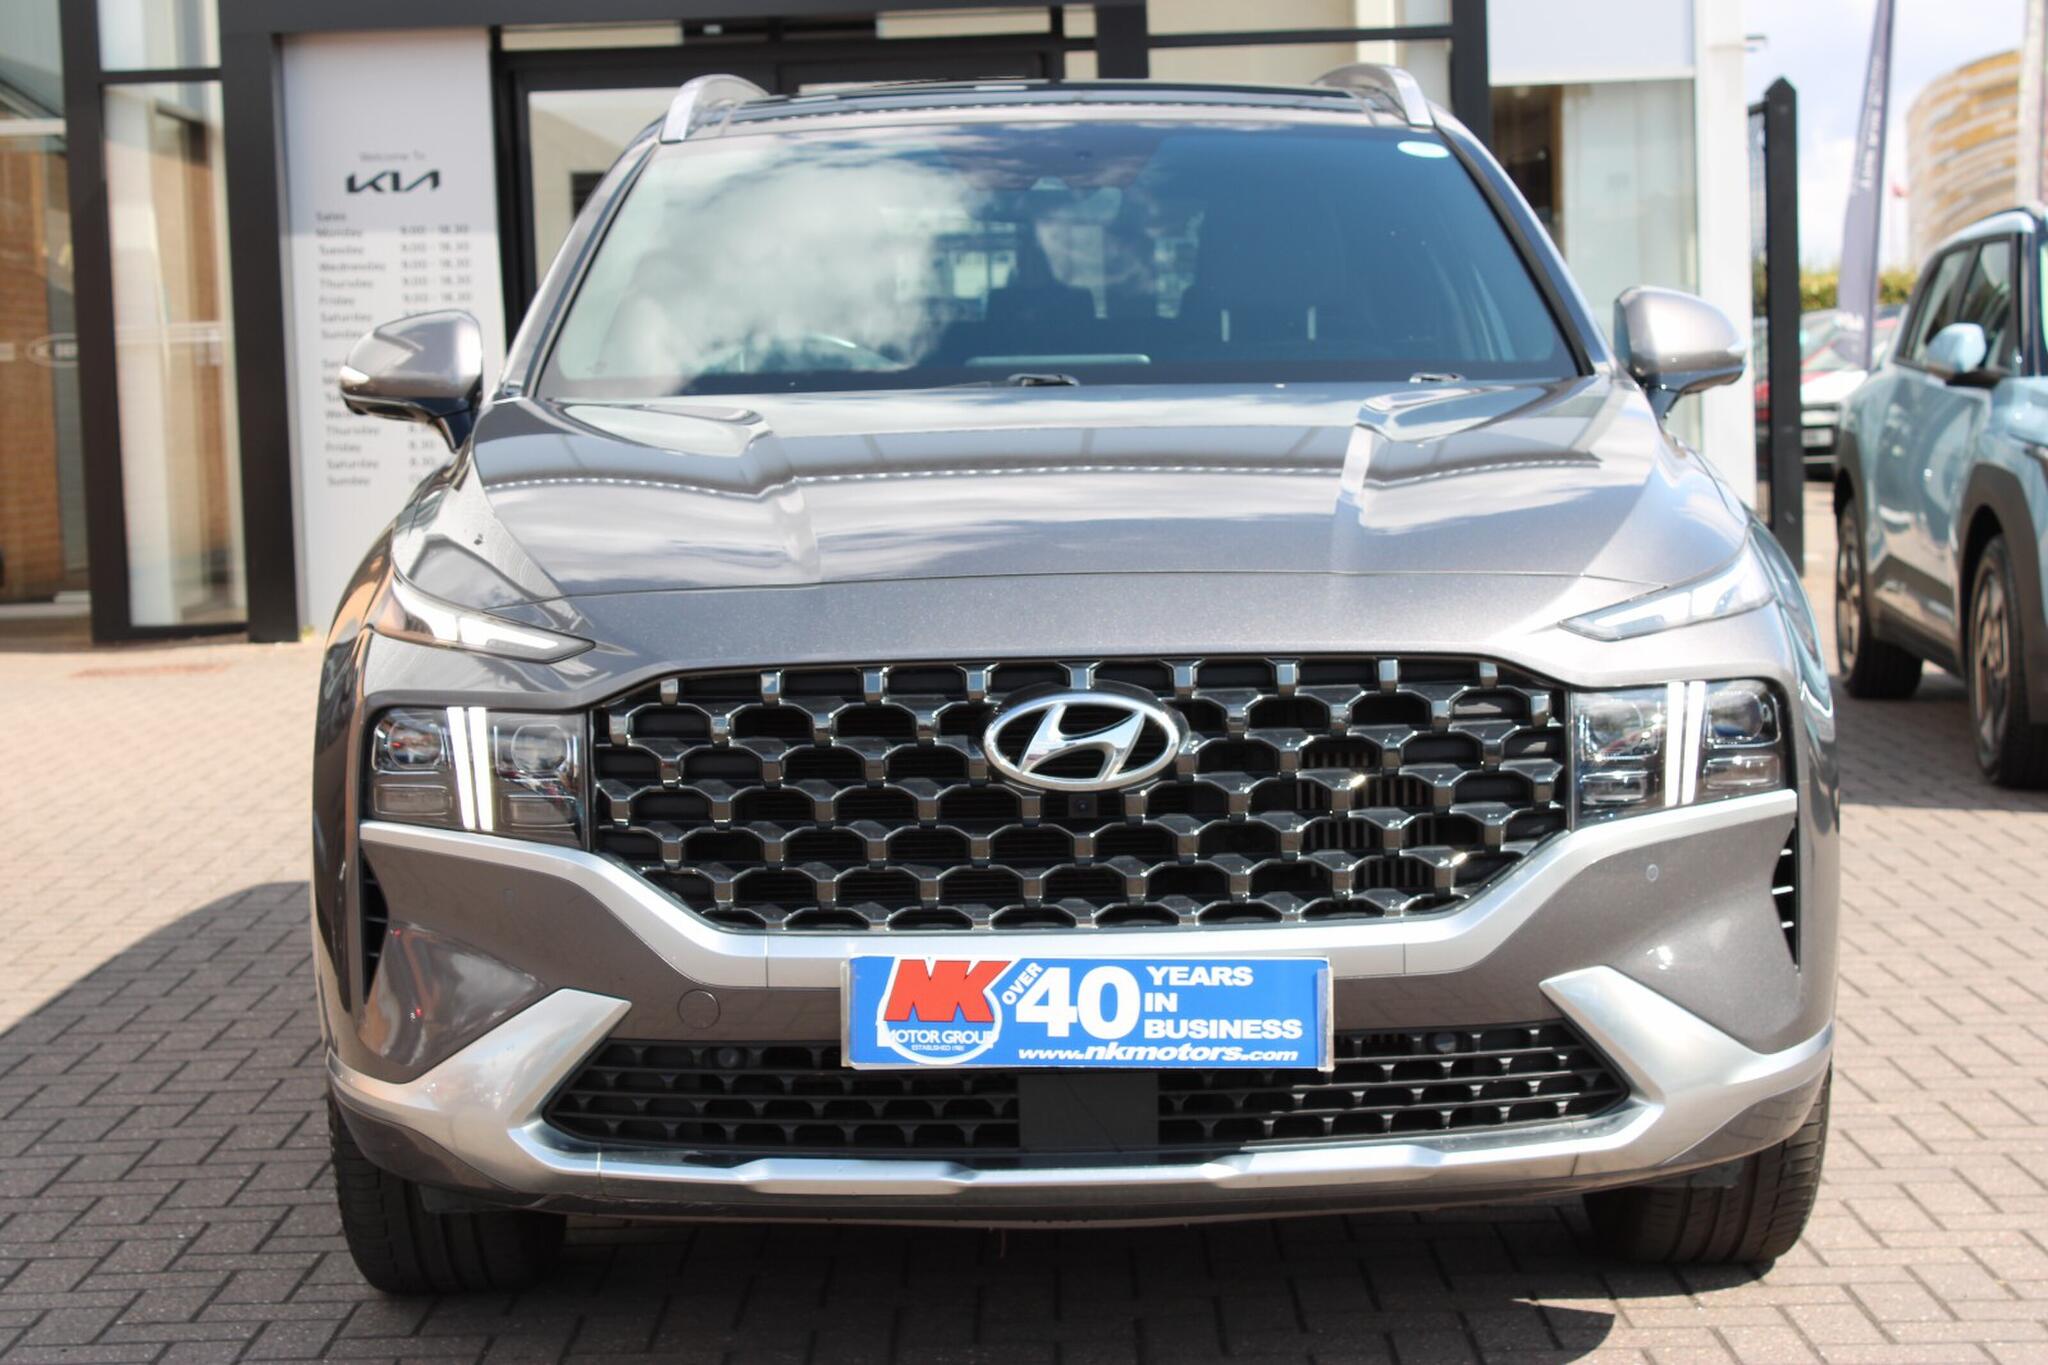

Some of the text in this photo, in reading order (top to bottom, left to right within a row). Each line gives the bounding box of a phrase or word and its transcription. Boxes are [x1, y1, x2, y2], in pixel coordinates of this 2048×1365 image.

[346, 169, 440, 194] KIA
[316, 228, 362, 238] Monday
[319, 245, 364, 255] Tuesday
[319, 262, 386, 272] Wednesday
[320, 279, 373, 289] Thursday
[319, 295, 355, 306] Friday
[321, 311, 372, 322] Saturday
[1001, 962, 1043, 1005] OVER
[1146, 966, 1254, 986] YEARS
[884, 959, 1012, 1022] NK
[1016, 965, 1141, 1039] 40
[1144, 992, 1178, 1012] IN
[1144, 1019, 1303, 1039] BUSINESS
[1018, 1042, 1298, 1061] www.nkmotors.com
